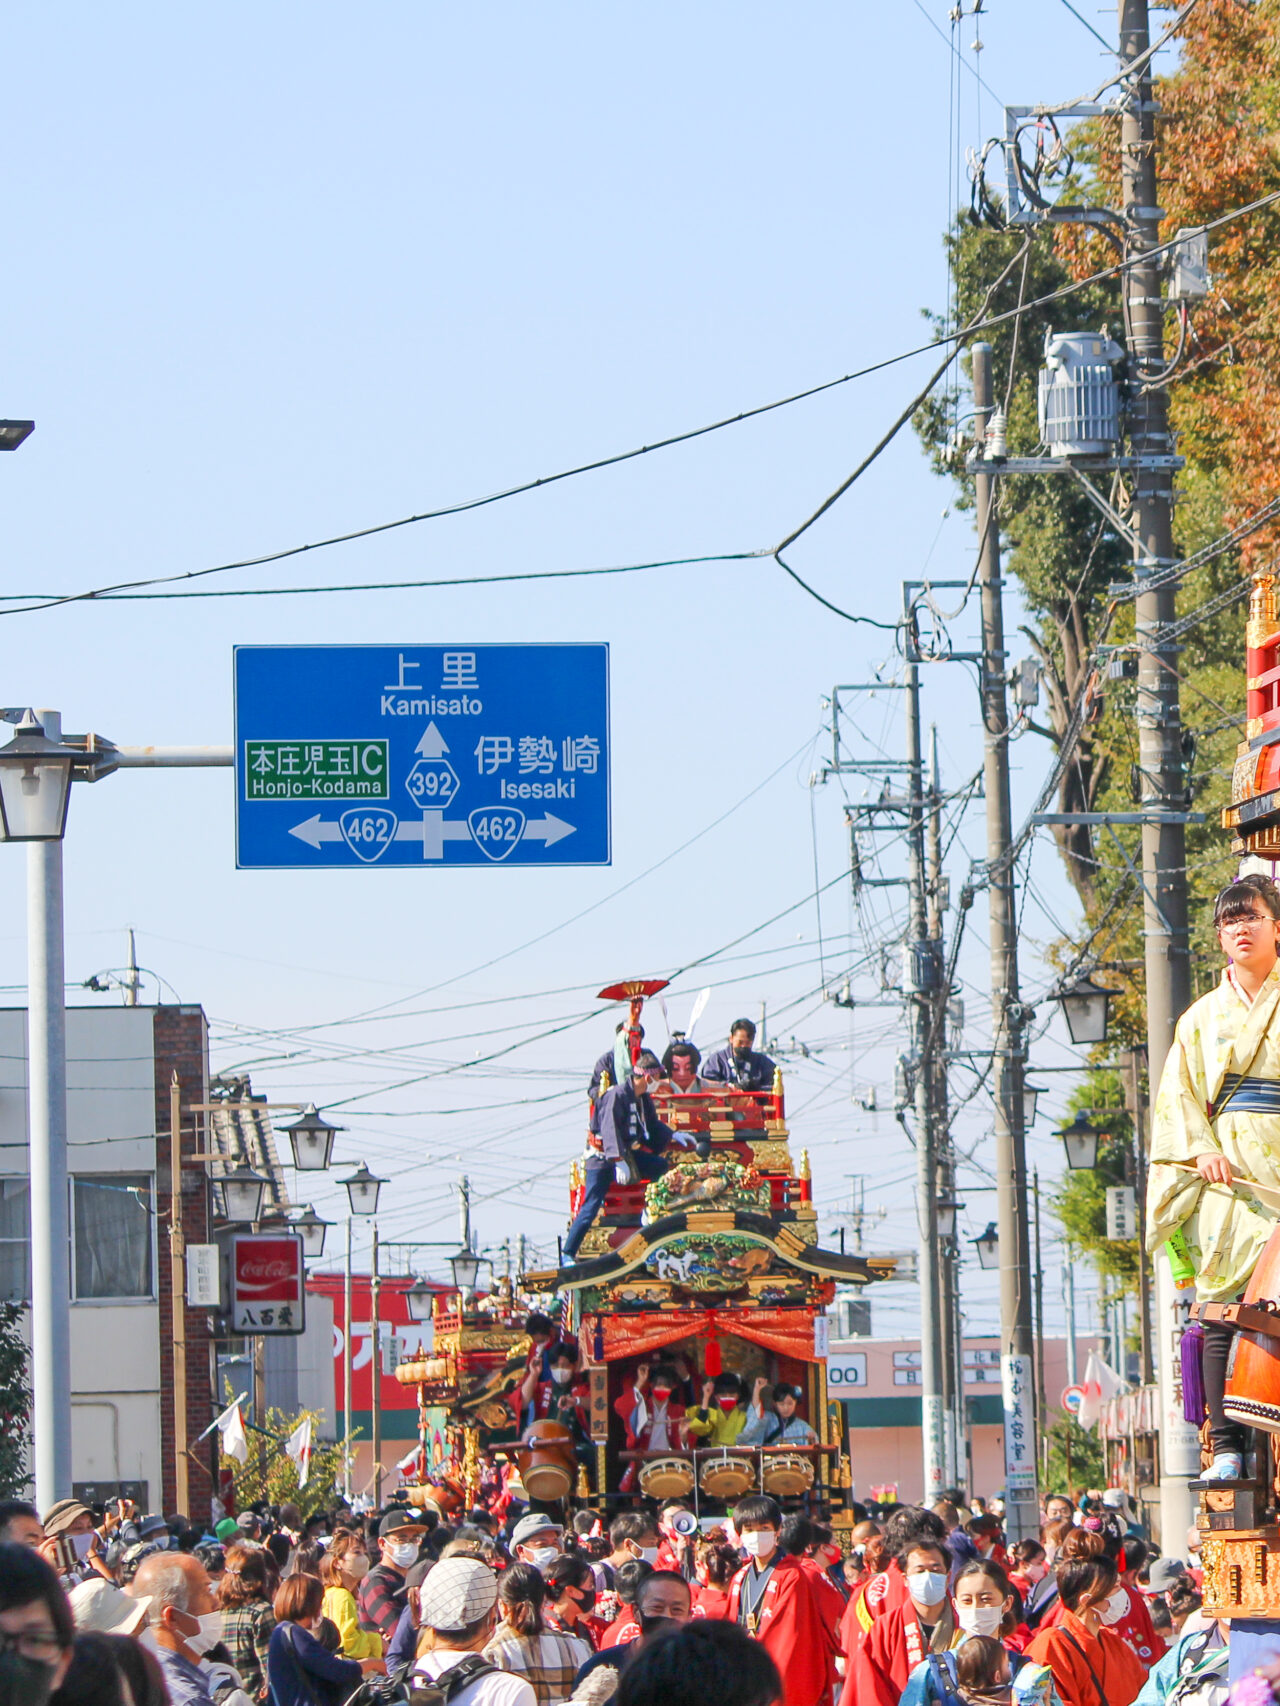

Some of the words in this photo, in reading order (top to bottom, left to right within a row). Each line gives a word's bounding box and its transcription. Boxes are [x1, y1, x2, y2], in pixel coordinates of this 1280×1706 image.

[384, 652, 479, 691] 上里
[380, 695, 483, 717] Kamisato
[250, 745, 383, 776] 本庄児玉IC
[473, 735, 601, 775] 伊勢崎
[252, 779, 383, 799] Honjo-Kodama
[411, 773, 452, 796] 392
[500, 779, 576, 800] Isesaki
[347, 818, 389, 842] 462
[476, 817, 517, 841] 462
